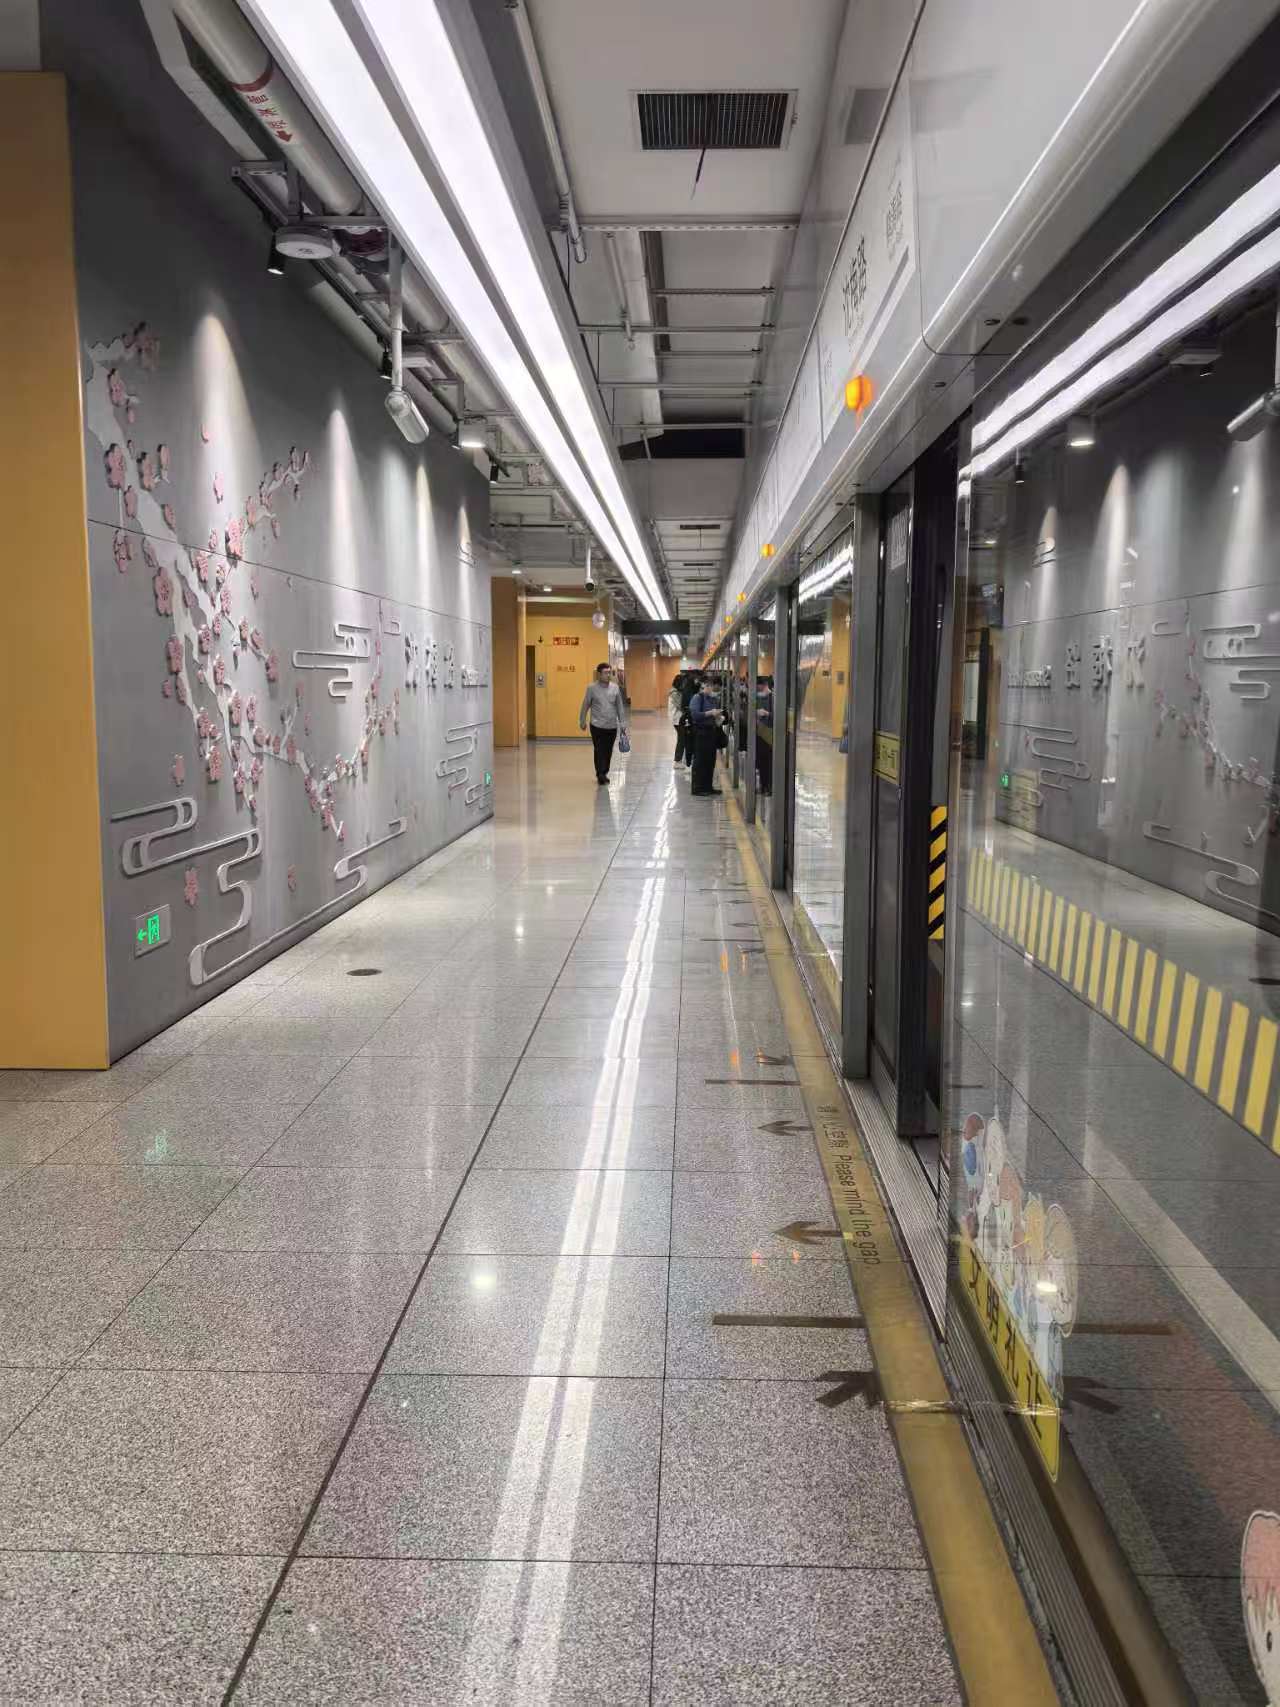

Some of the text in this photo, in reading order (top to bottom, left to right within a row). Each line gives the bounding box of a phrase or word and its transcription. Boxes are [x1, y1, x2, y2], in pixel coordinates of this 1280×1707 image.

[833, 1155, 856, 1187] Please
[843, 1188, 867, 1218] mind
[852, 1219, 872, 1238] the
[969, 1248, 1042, 1438] 文明礼让
